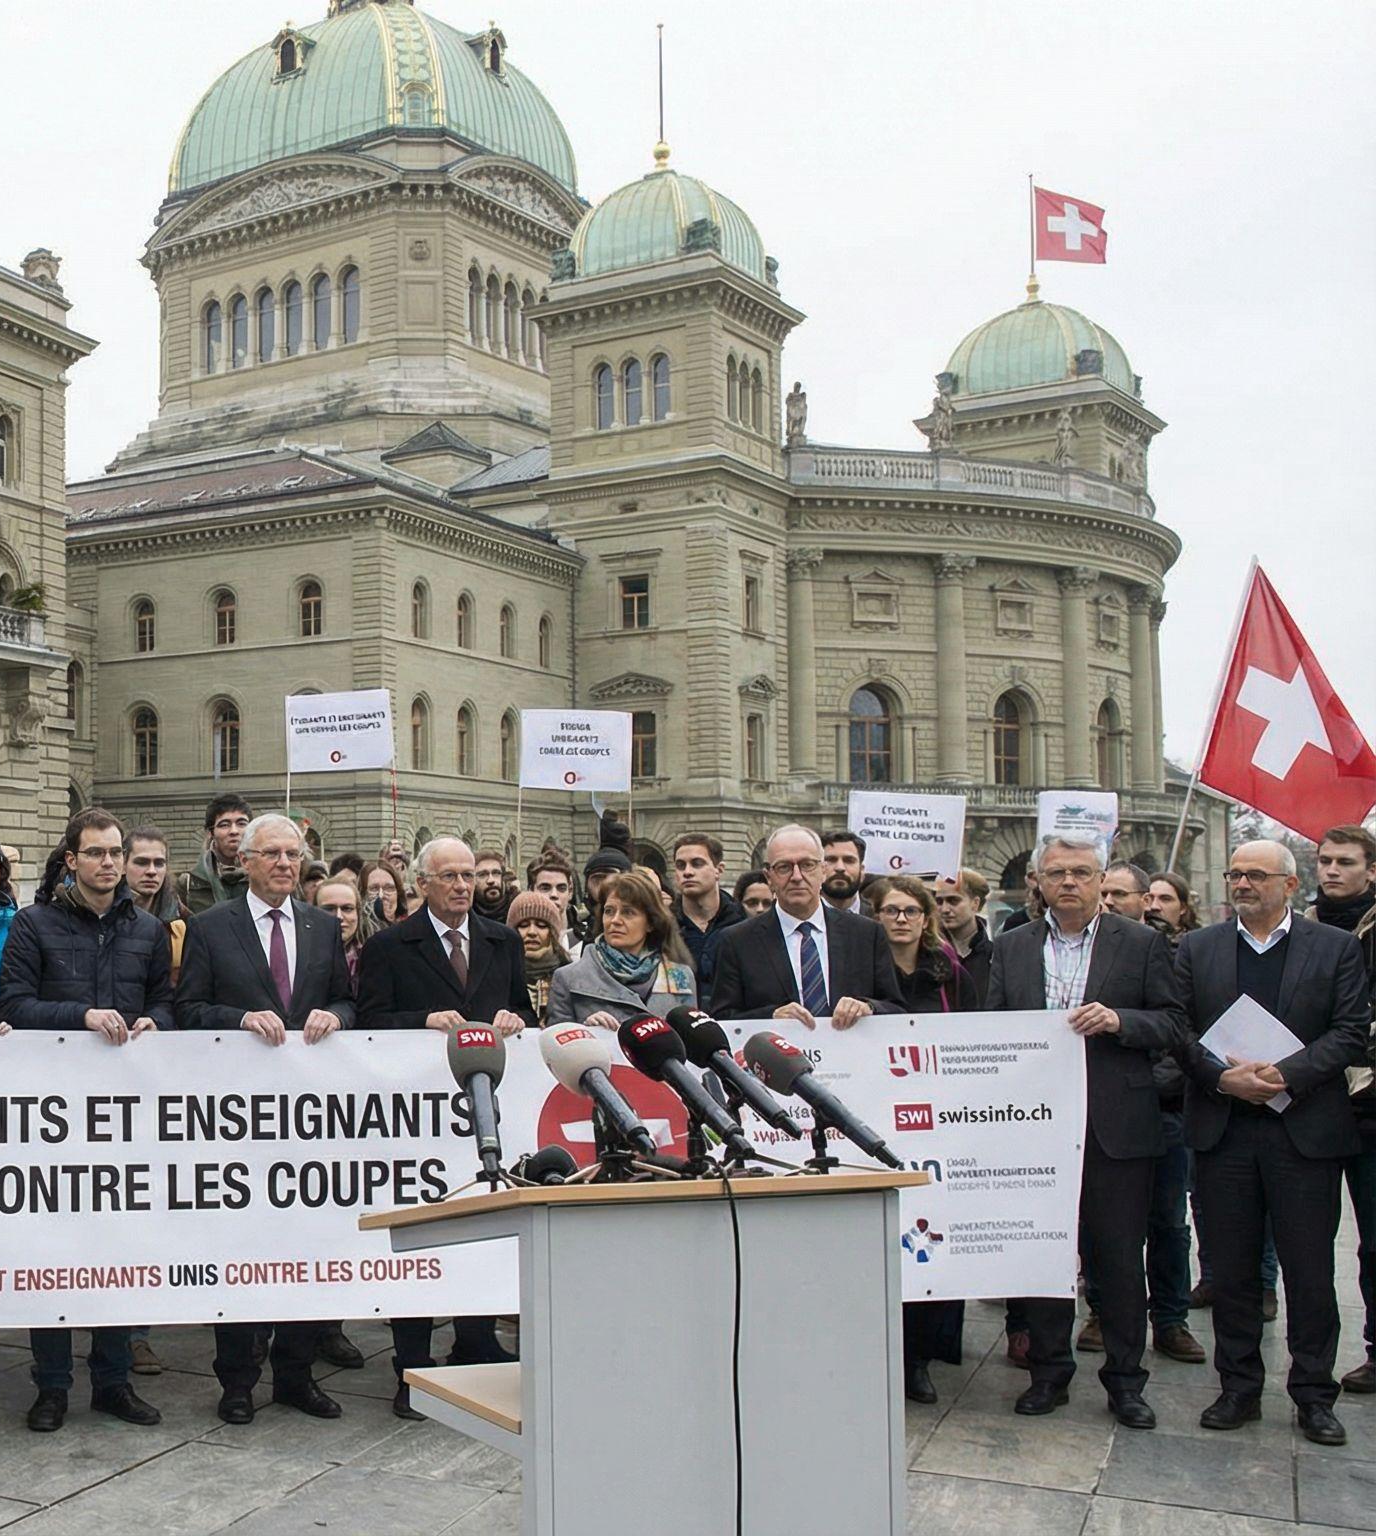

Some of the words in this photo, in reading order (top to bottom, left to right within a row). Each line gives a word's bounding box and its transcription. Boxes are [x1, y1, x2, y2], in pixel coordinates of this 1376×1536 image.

[460, 1031, 493, 1044] SWI
[636, 1020, 665, 1037] SWI
[86, 1095, 141, 1143] ET
[158, 1091, 476, 1142] ENSEIGNANTS
[898, 1110, 929, 1124] SWI
[938, 1103, 1053, 1124] swissinfo.ch
[167, 1161, 251, 1211] LES
[267, 1158, 449, 1209] COUPES
[13, 1265, 162, 1292] ENSEIGNANTS
[168, 1263, 219, 1288] UNIS
[225, 1261, 309, 1286] CONTRE
[315, 1260, 353, 1283] LES
[359, 1257, 442, 1282] COUPES
